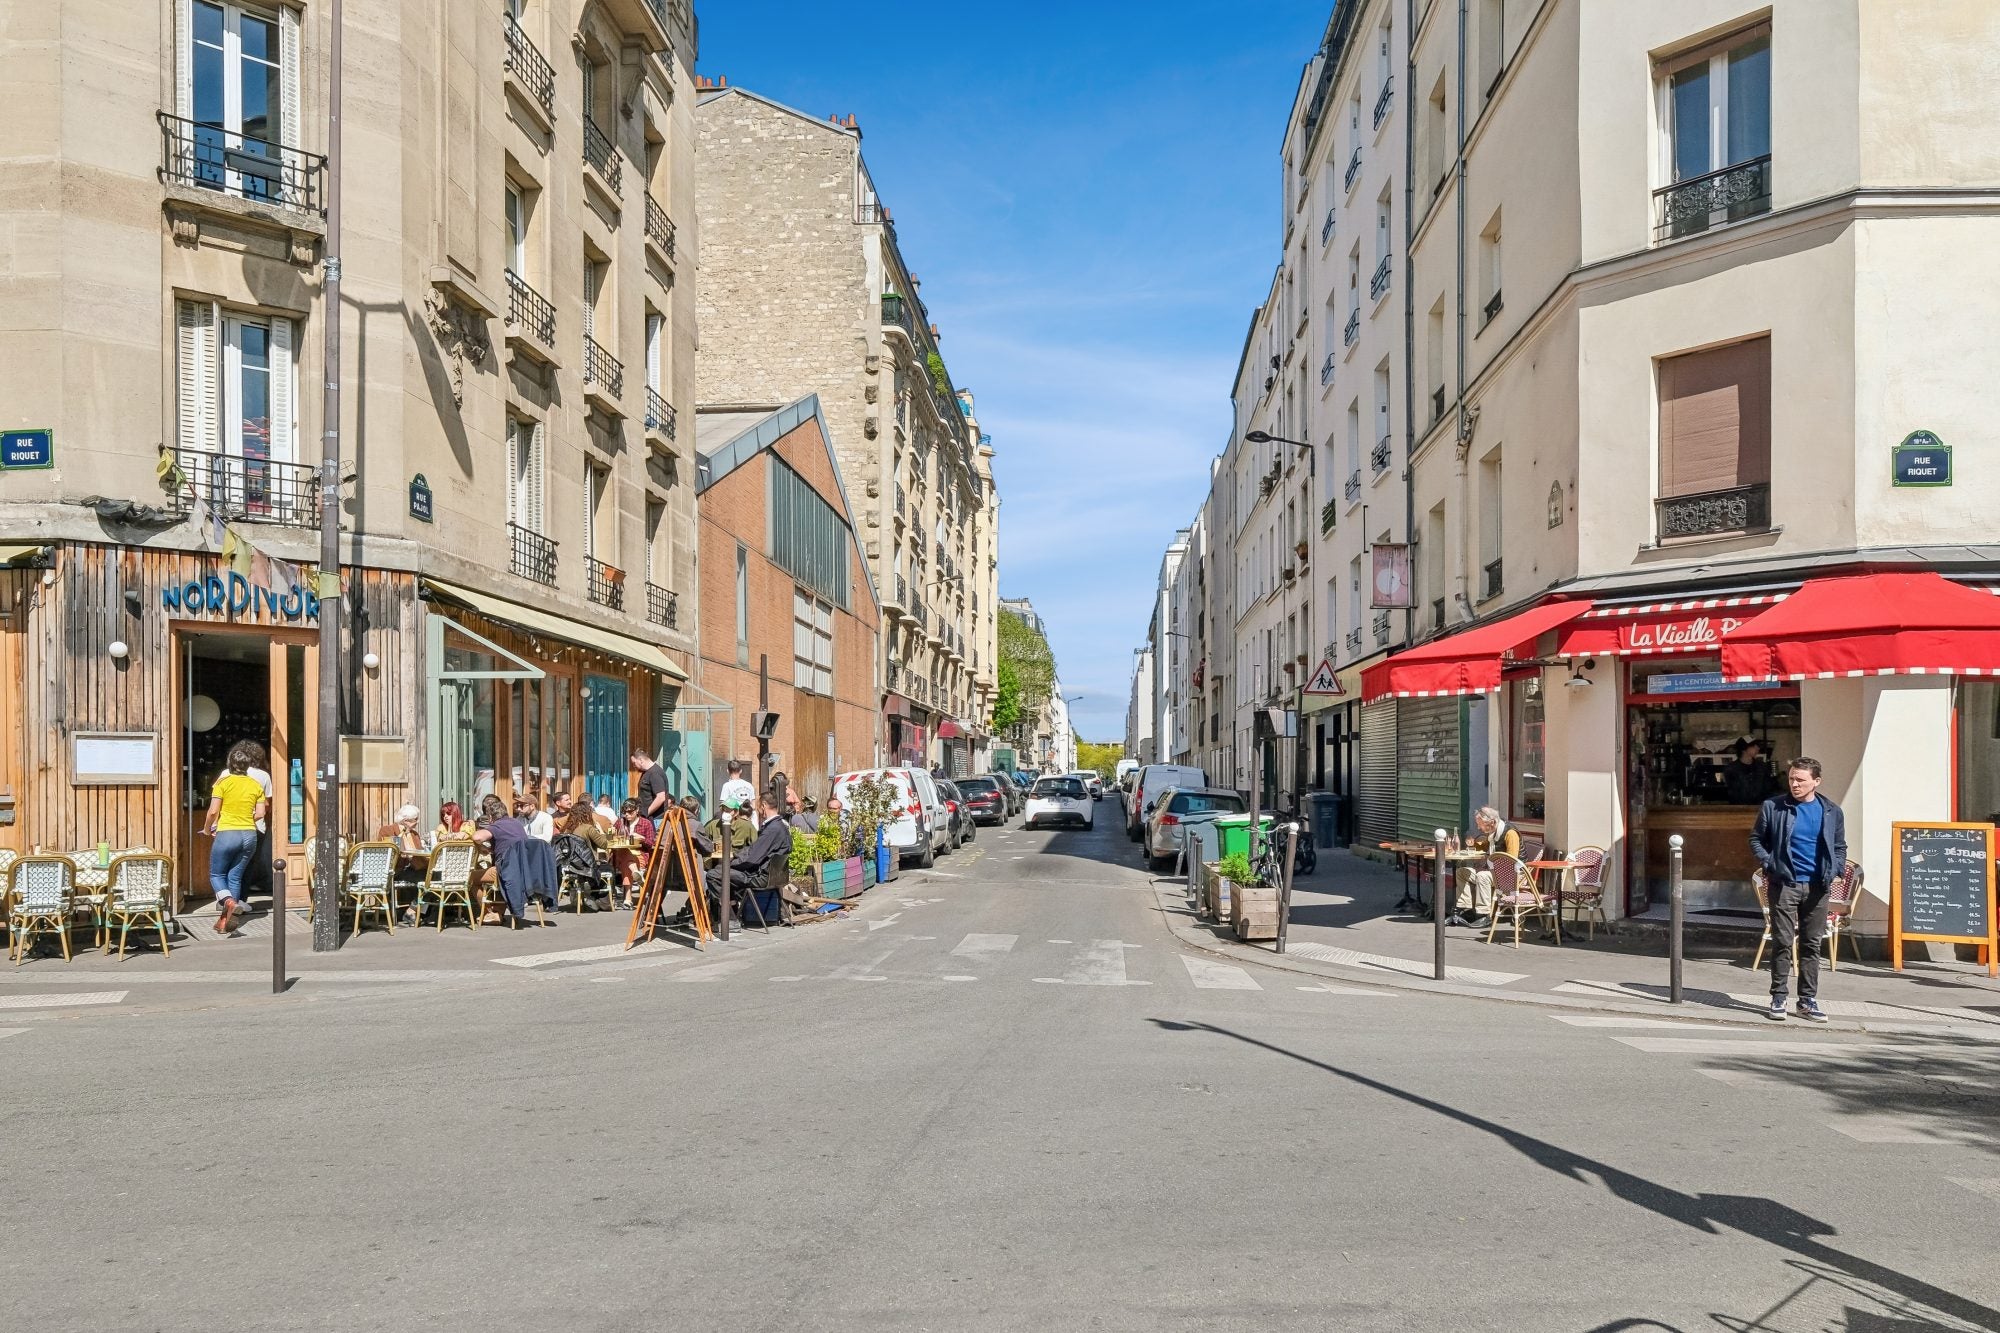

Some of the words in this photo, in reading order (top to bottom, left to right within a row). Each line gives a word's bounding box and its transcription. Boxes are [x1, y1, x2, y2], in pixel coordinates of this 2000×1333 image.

[17, 438, 33, 447] RUE
[11, 451, 40, 461] RIQUET
[416, 492, 426, 503] RUE
[413, 501, 429, 515] PAJOL
[1630, 622, 1653, 647] La
[1655, 617, 1718, 645] Vieille
